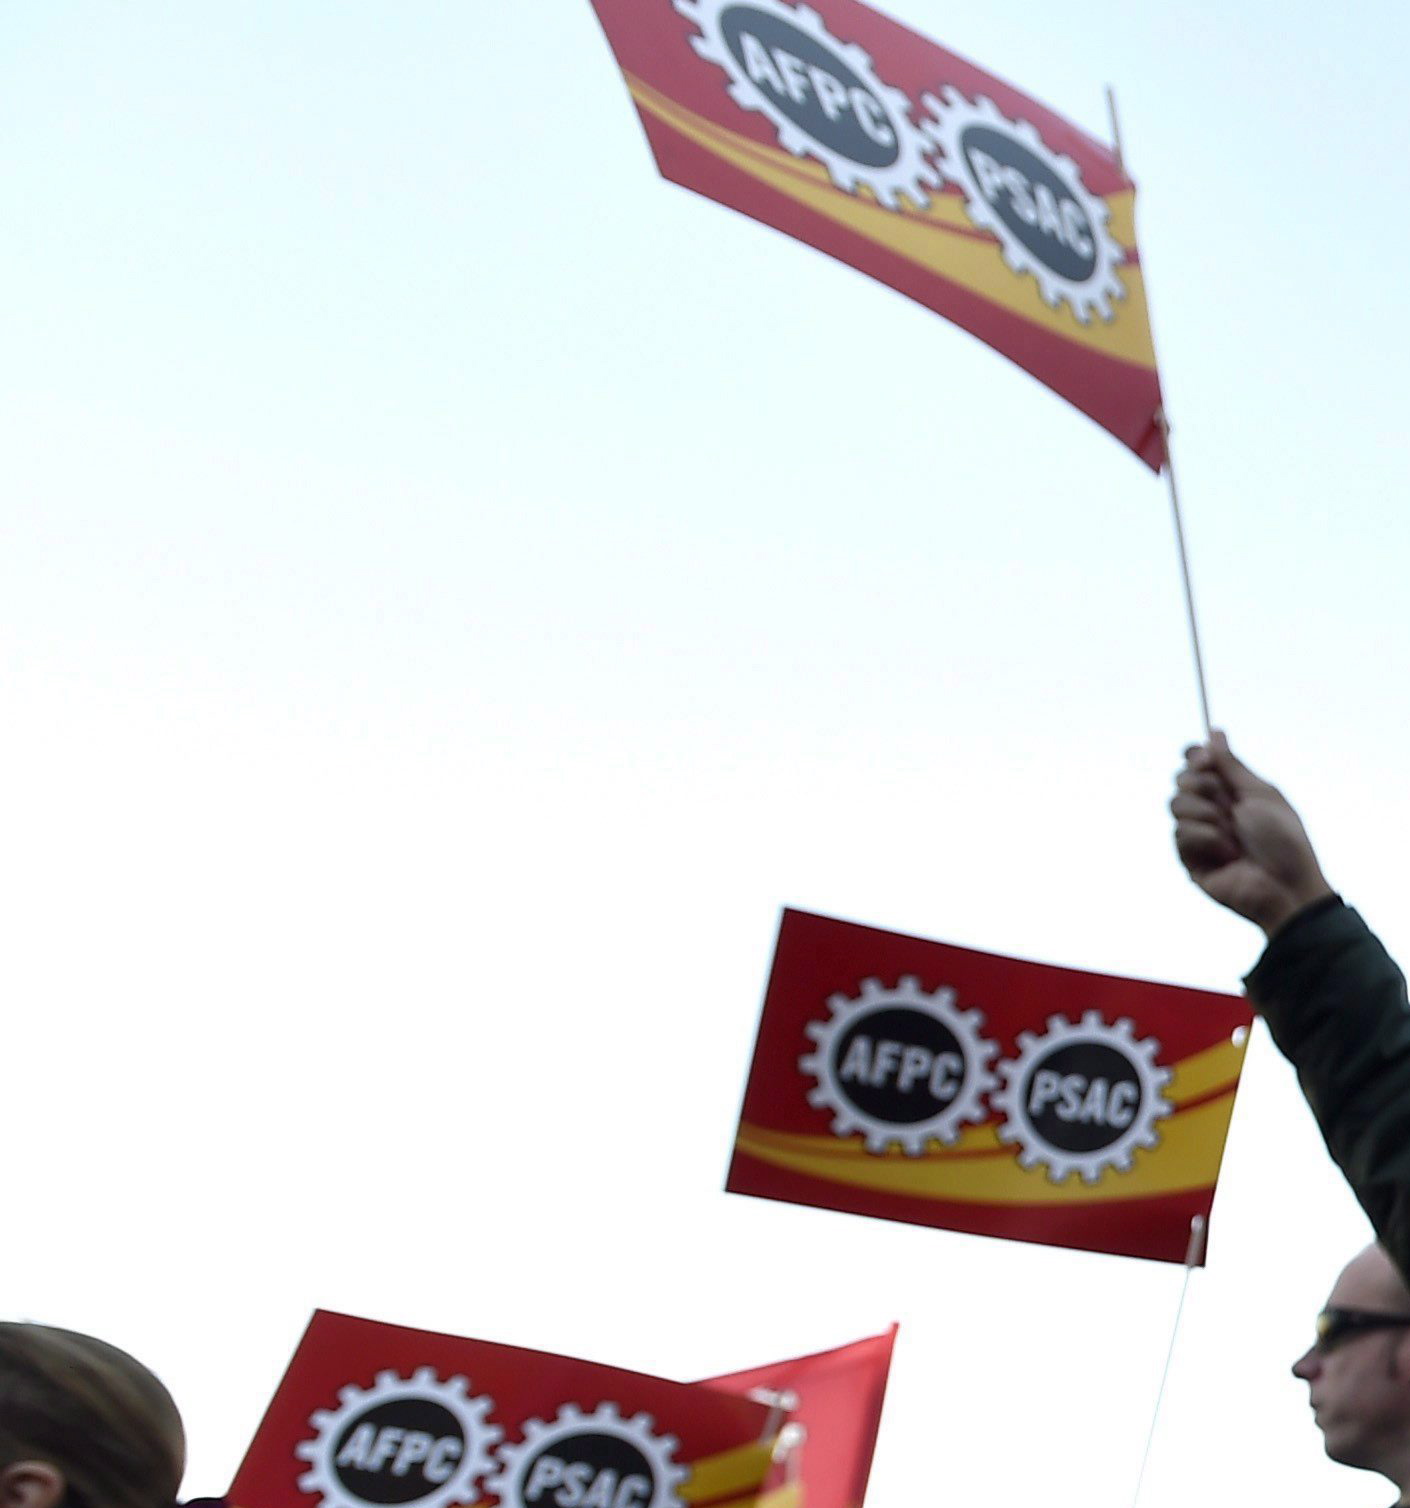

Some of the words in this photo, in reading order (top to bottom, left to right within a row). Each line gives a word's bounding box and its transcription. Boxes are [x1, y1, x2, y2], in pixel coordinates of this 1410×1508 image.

[739, 31, 892, 144] AFPC
[973, 148, 1095, 259] PSAC
[840, 1034, 964, 1101] AFPC
[1028, 1069, 1139, 1129] PSAC
[336, 1421, 464, 1484] AFPC
